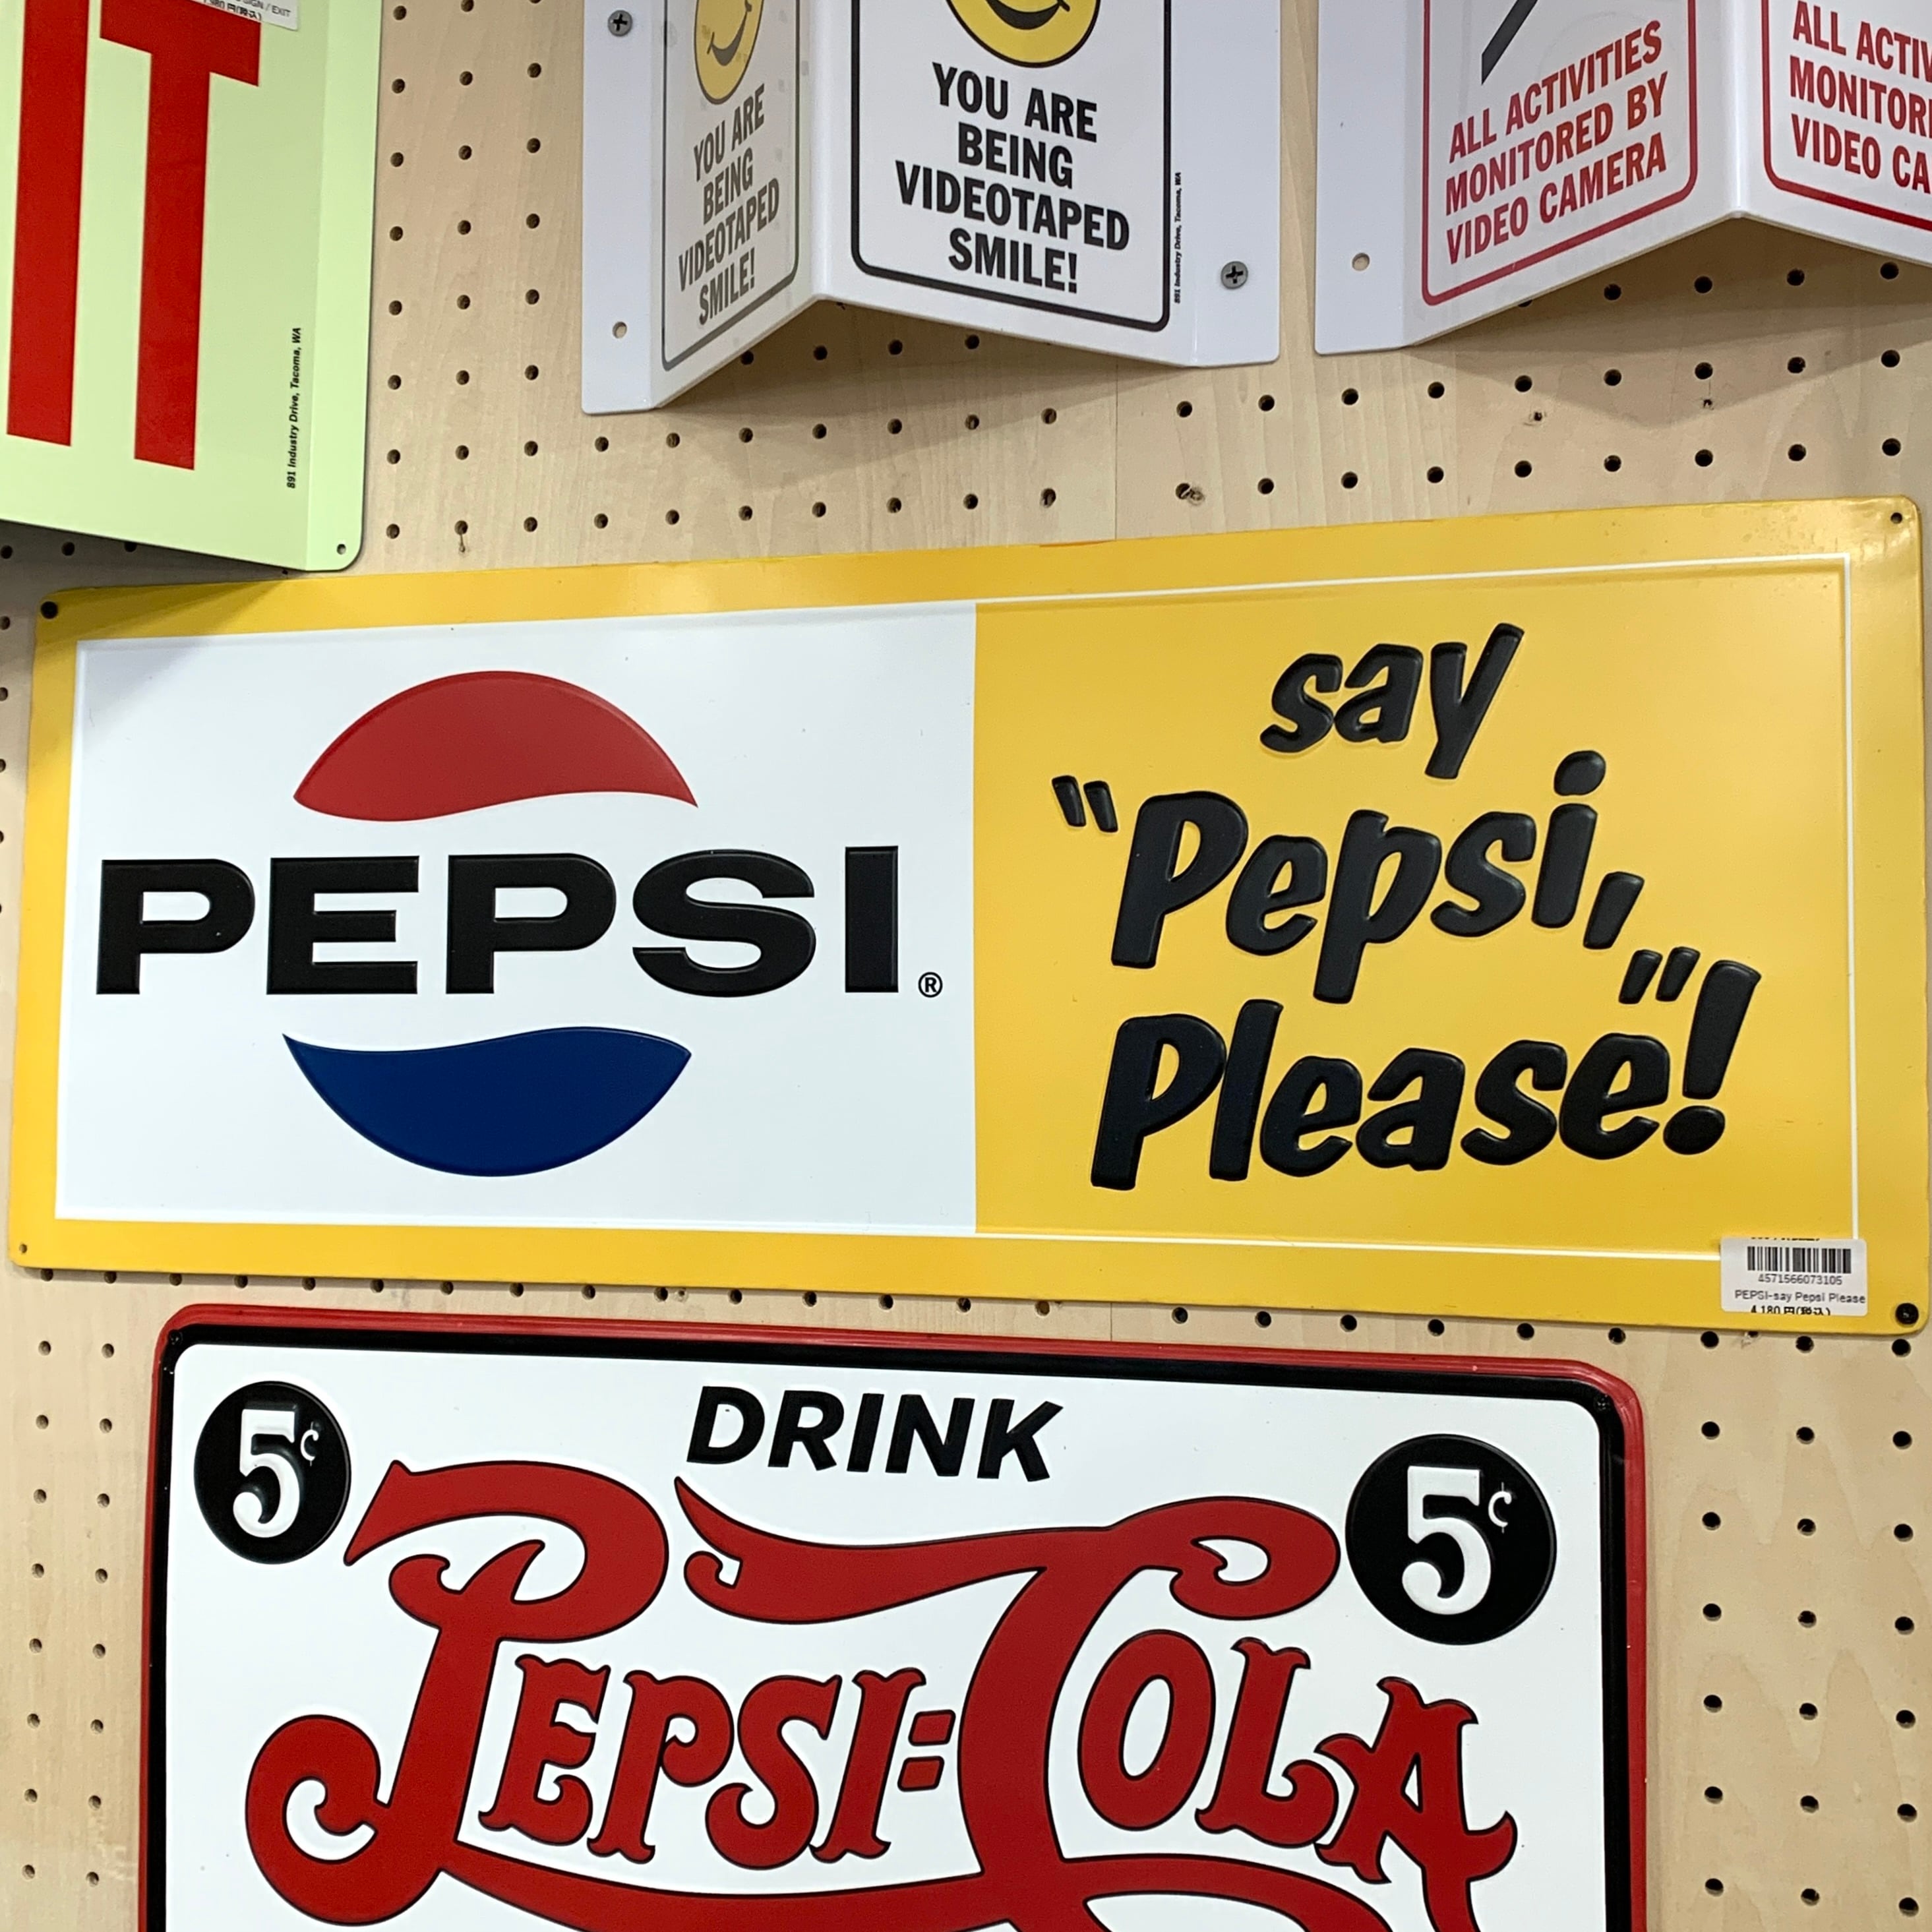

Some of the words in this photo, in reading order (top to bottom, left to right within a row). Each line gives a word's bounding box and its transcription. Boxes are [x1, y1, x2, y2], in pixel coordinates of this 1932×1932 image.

[272, 5, 291, 17] EXIT
[1793, 0, 1846, 55] ALL
[932, 62, 1008, 119] YOU
[1025, 88, 1097, 142] ARE
[1450, 107, 1496, 163] ALL
[1506, 20, 1662, 135] ACTIVITIES
[694, 121, 725, 181] YOU
[731, 84, 764, 152] ARE
[957, 123, 1073, 189] BEING
[1446, 102, 1613, 215] MONITORED
[1627, 72, 1668, 131] BY
[1792, 113, 1881, 179] VIDEO
[704, 147, 752, 224] BEING
[895, 160, 1129, 250] VIDEOTAPED
[1175, 172, 1181, 185] WA
[1446, 196, 1528, 264] VIDEO
[1540, 133, 1666, 224] CAMERA
[679, 177, 779, 291] VIDEOTAPED
[948, 228, 1077, 293] SMILE!
[699, 247, 754, 325] SMILE!
[290, 347, 301, 388] Tacoma,
[292, 328, 301, 344] WA
[289, 393, 299, 422] Drive,
[287, 425, 299, 468] Industry
[287, 471, 296, 489] 891
[1260, 622, 1524, 779] say
[96, 845, 898, 998] PEPSI
[1735, 1290, 1792, 1302] PEPSI-say
[1796, 1292, 1825, 1303] Pepsi
[1828, 1293, 1865, 1304] Please
[1758, 1273, 1842, 1285] 4571566073105
[686, 1386, 1063, 1482] DRINK
